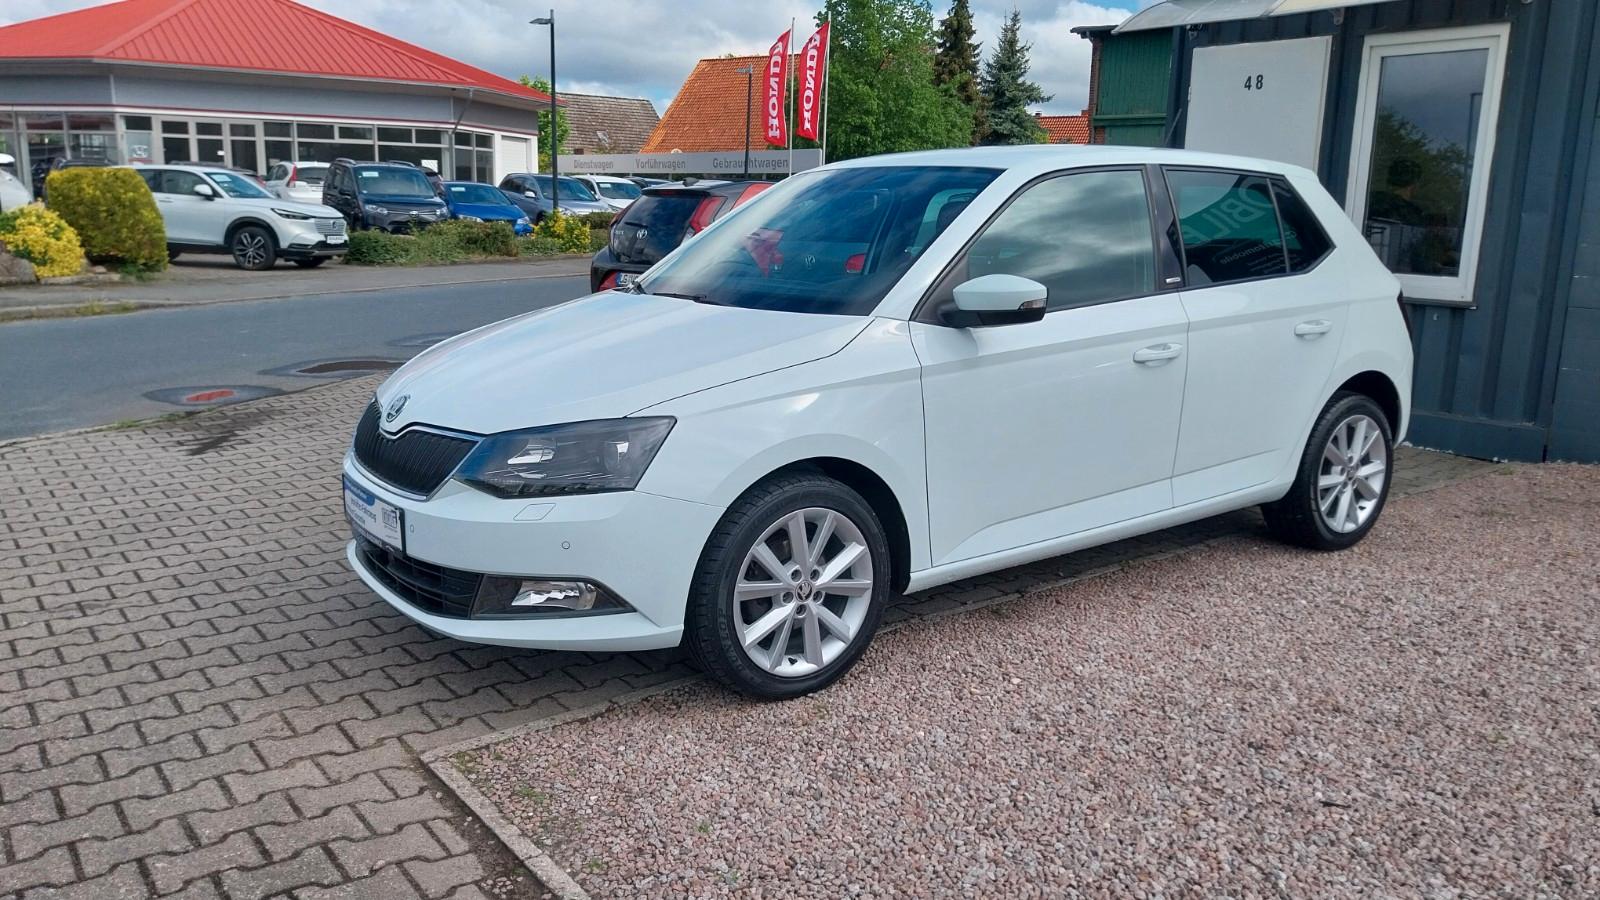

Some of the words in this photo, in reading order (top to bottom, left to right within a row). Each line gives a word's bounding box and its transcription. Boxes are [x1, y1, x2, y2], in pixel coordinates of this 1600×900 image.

[768, 41, 783, 138] HONDA
[803, 33, 821, 132] HONDA
[1243, 74, 1264, 91] 48
[573, 159, 614, 170] Dienstwagen
[635, 158, 686, 171] Vorführwagen
